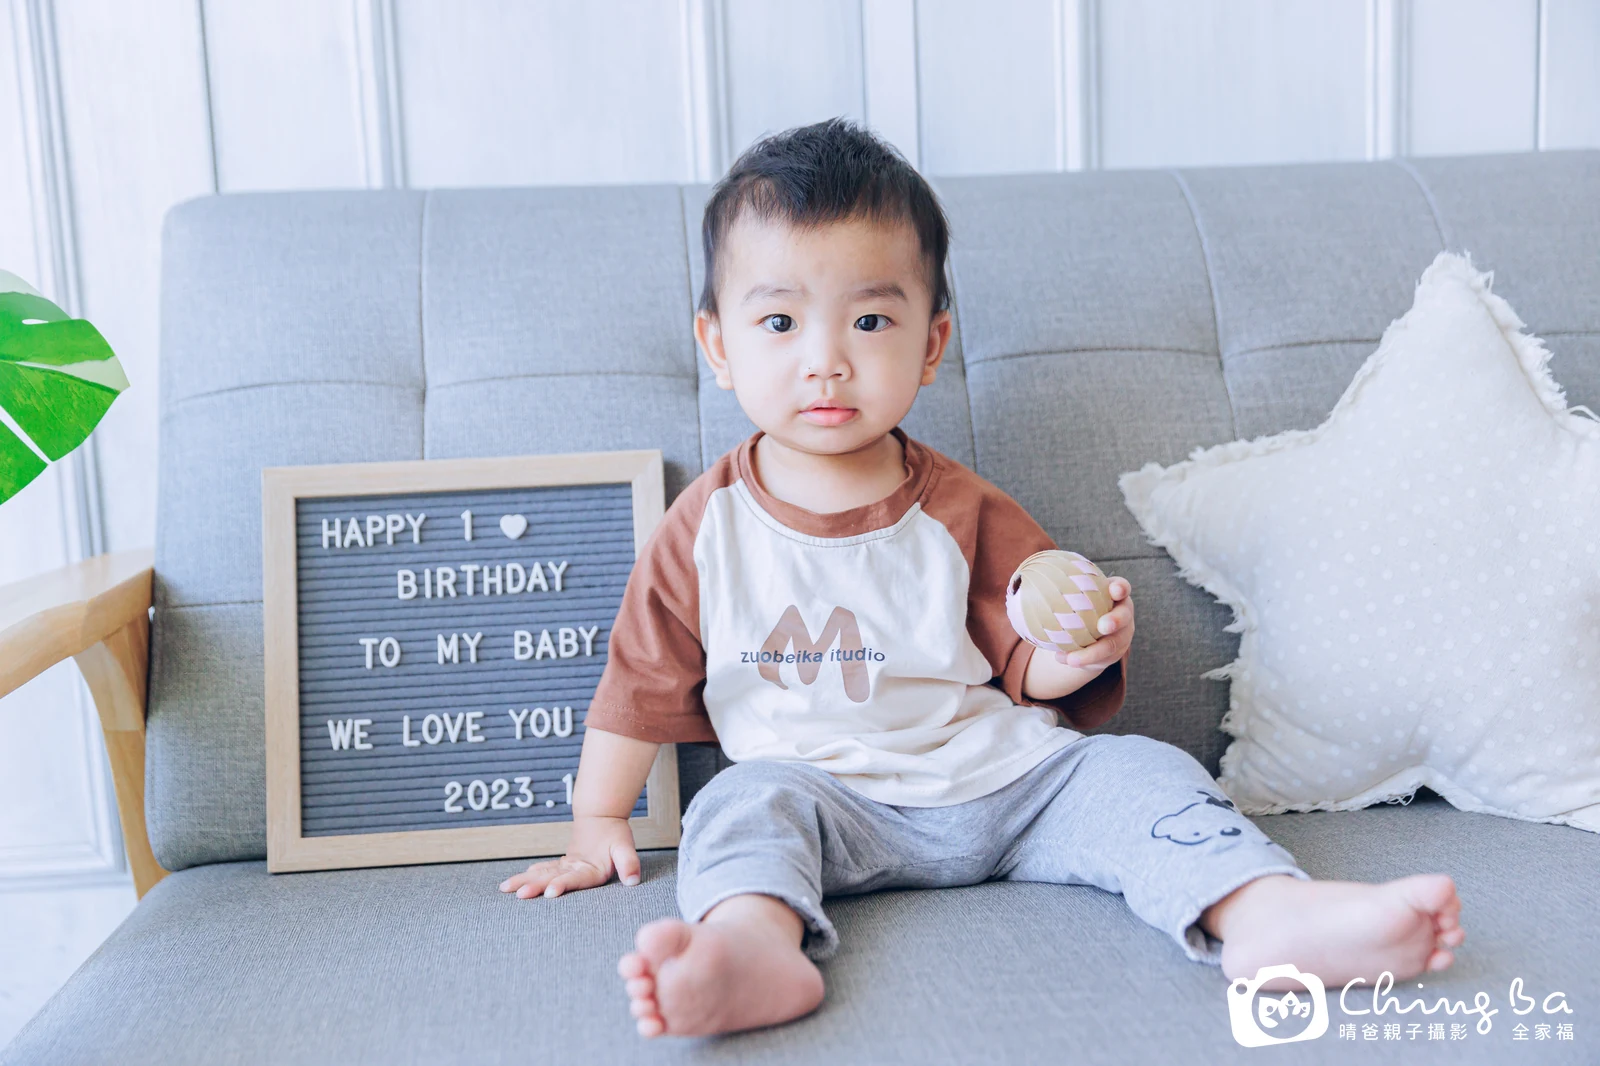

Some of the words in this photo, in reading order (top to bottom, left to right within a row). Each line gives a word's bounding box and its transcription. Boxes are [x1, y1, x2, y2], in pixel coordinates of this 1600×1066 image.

[321, 512, 425, 548] HAPPY
[460, 509, 473, 541] 1
[396, 560, 567, 599] BIRTHDAY
[358, 635, 400, 668] TO
[436, 631, 482, 664] MY
[513, 625, 598, 659] BABY
[740, 649, 823, 663] zuobeika
[829, 647, 885, 662] itudio
[327, 718, 372, 750] WE
[402, 711, 484, 745] LOVE
[508, 706, 572, 739] YOU
